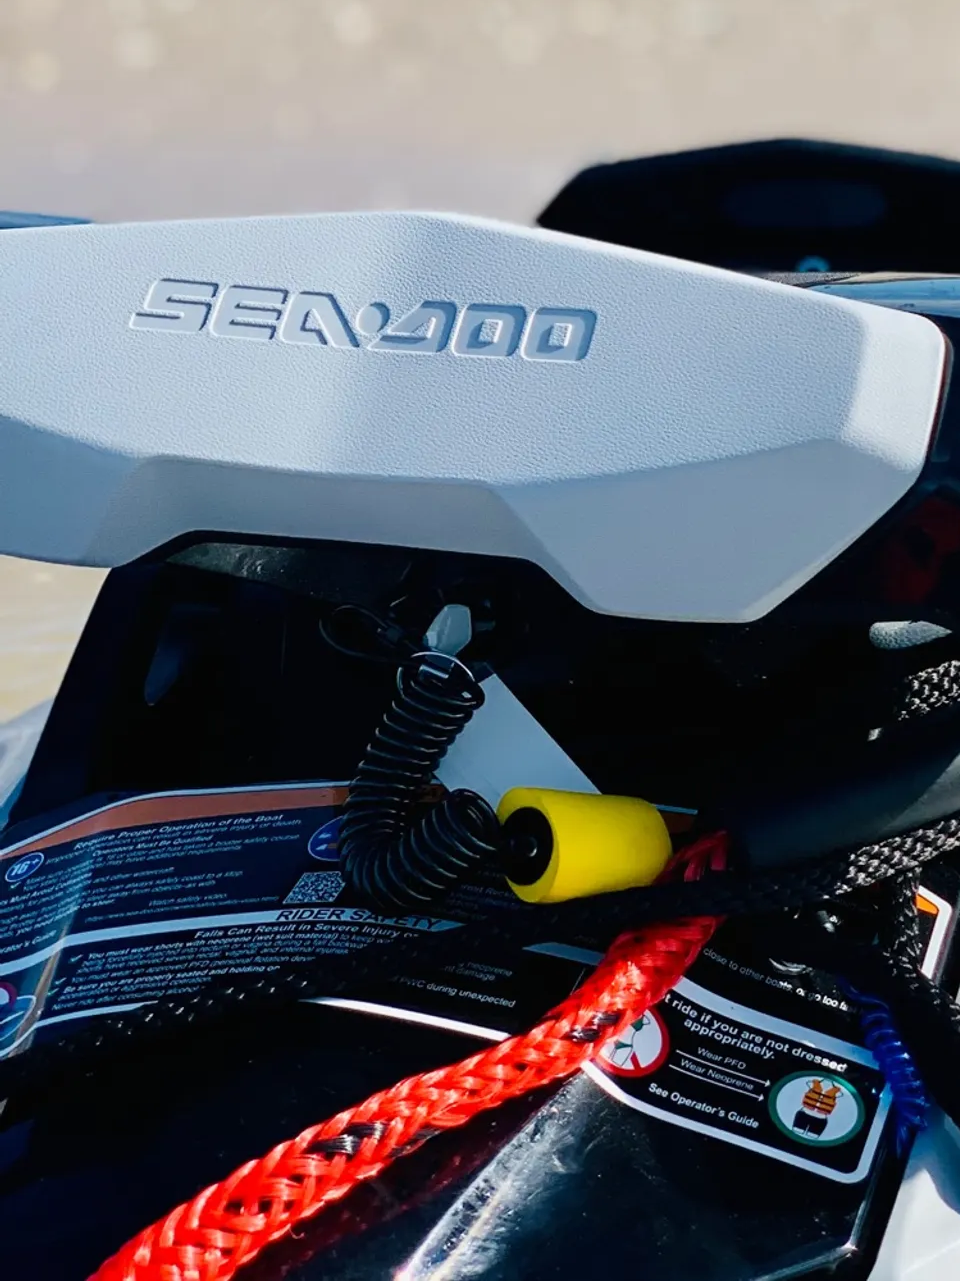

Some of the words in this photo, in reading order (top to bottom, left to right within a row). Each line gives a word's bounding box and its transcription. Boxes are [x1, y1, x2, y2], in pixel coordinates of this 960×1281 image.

[74, 834, 117, 851] Require
[118, 828, 158, 840] Proper
[159, 821, 216, 834] Operation
[219, 818, 233, 826] of
[233, 817, 254, 825] the
[255, 814, 284, 823] Boat
[92, 845, 135, 858] Operators
[135, 840, 158, 850] Must
[158, 839, 172, 848] Be
[172, 834, 215, 846] Qualified
[194, 928, 226, 940] Falls
[227, 925, 253, 936] Can
[254, 922, 296, 934] Result
[298, 922, 313, 932] in
[313, 923, 360, 933] Severe
[361, 925, 401, 939] Injury
[276, 909, 347, 922] RIDER
[207, 935, 252, 946] neoprene
[703, 947, 729, 968] close
[728, 960, 740, 972] to
[739, 965, 766, 985] other
[426, 982, 459, 998] during
[457, 987, 517, 1009] unexpected
[670, 1000, 700, 1019] ride
[699, 1011, 712, 1025] if
[711, 1019, 740, 1038] you
[740, 1028, 765, 1045] are
[764, 1038, 791, 1055] not
[789, 1046, 851, 1074] dressed
[682, 1016, 778, 1062] appropriately.
[695, 1044, 726, 1063] Wear
[723, 1055, 748, 1072] PFD
[679, 1058, 708, 1077] Wear
[706, 1067, 757, 1093] Neoprene
[646, 1080, 670, 1101] See
[668, 1089, 727, 1119] Operator's
[725, 1110, 762, 1131] Guide
